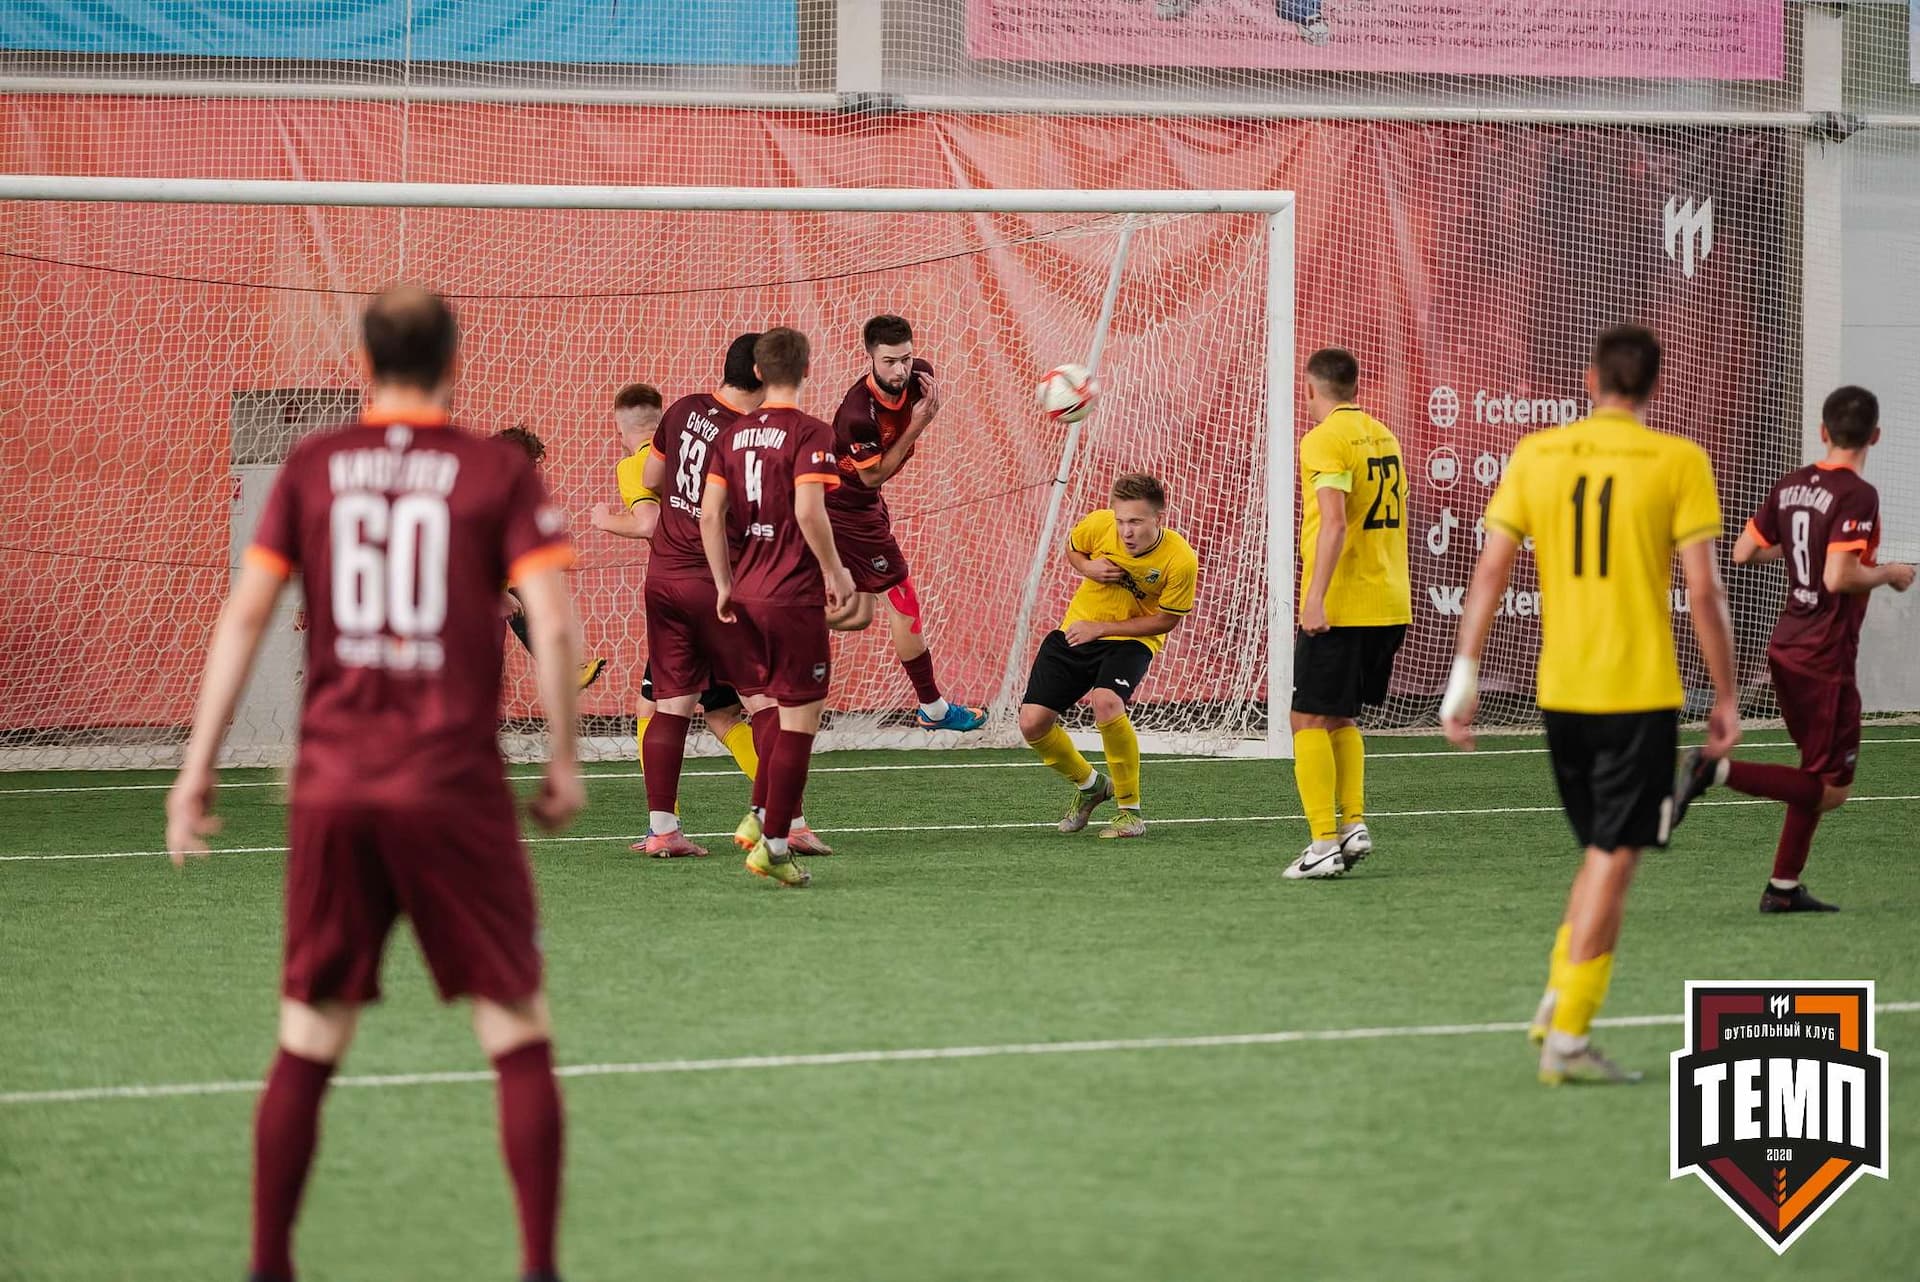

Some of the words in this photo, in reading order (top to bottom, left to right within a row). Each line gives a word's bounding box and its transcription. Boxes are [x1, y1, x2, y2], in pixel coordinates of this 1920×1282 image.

[686, 411, 720, 443] СЫЧЕВ
[676, 430, 707, 504] 13
[744, 450, 763, 511] 4
[1363, 455, 1400, 530] 23
[1573, 476, 1614, 577] 11
[1791, 510, 1810, 587] 8
[330, 492, 451, 637] 60
